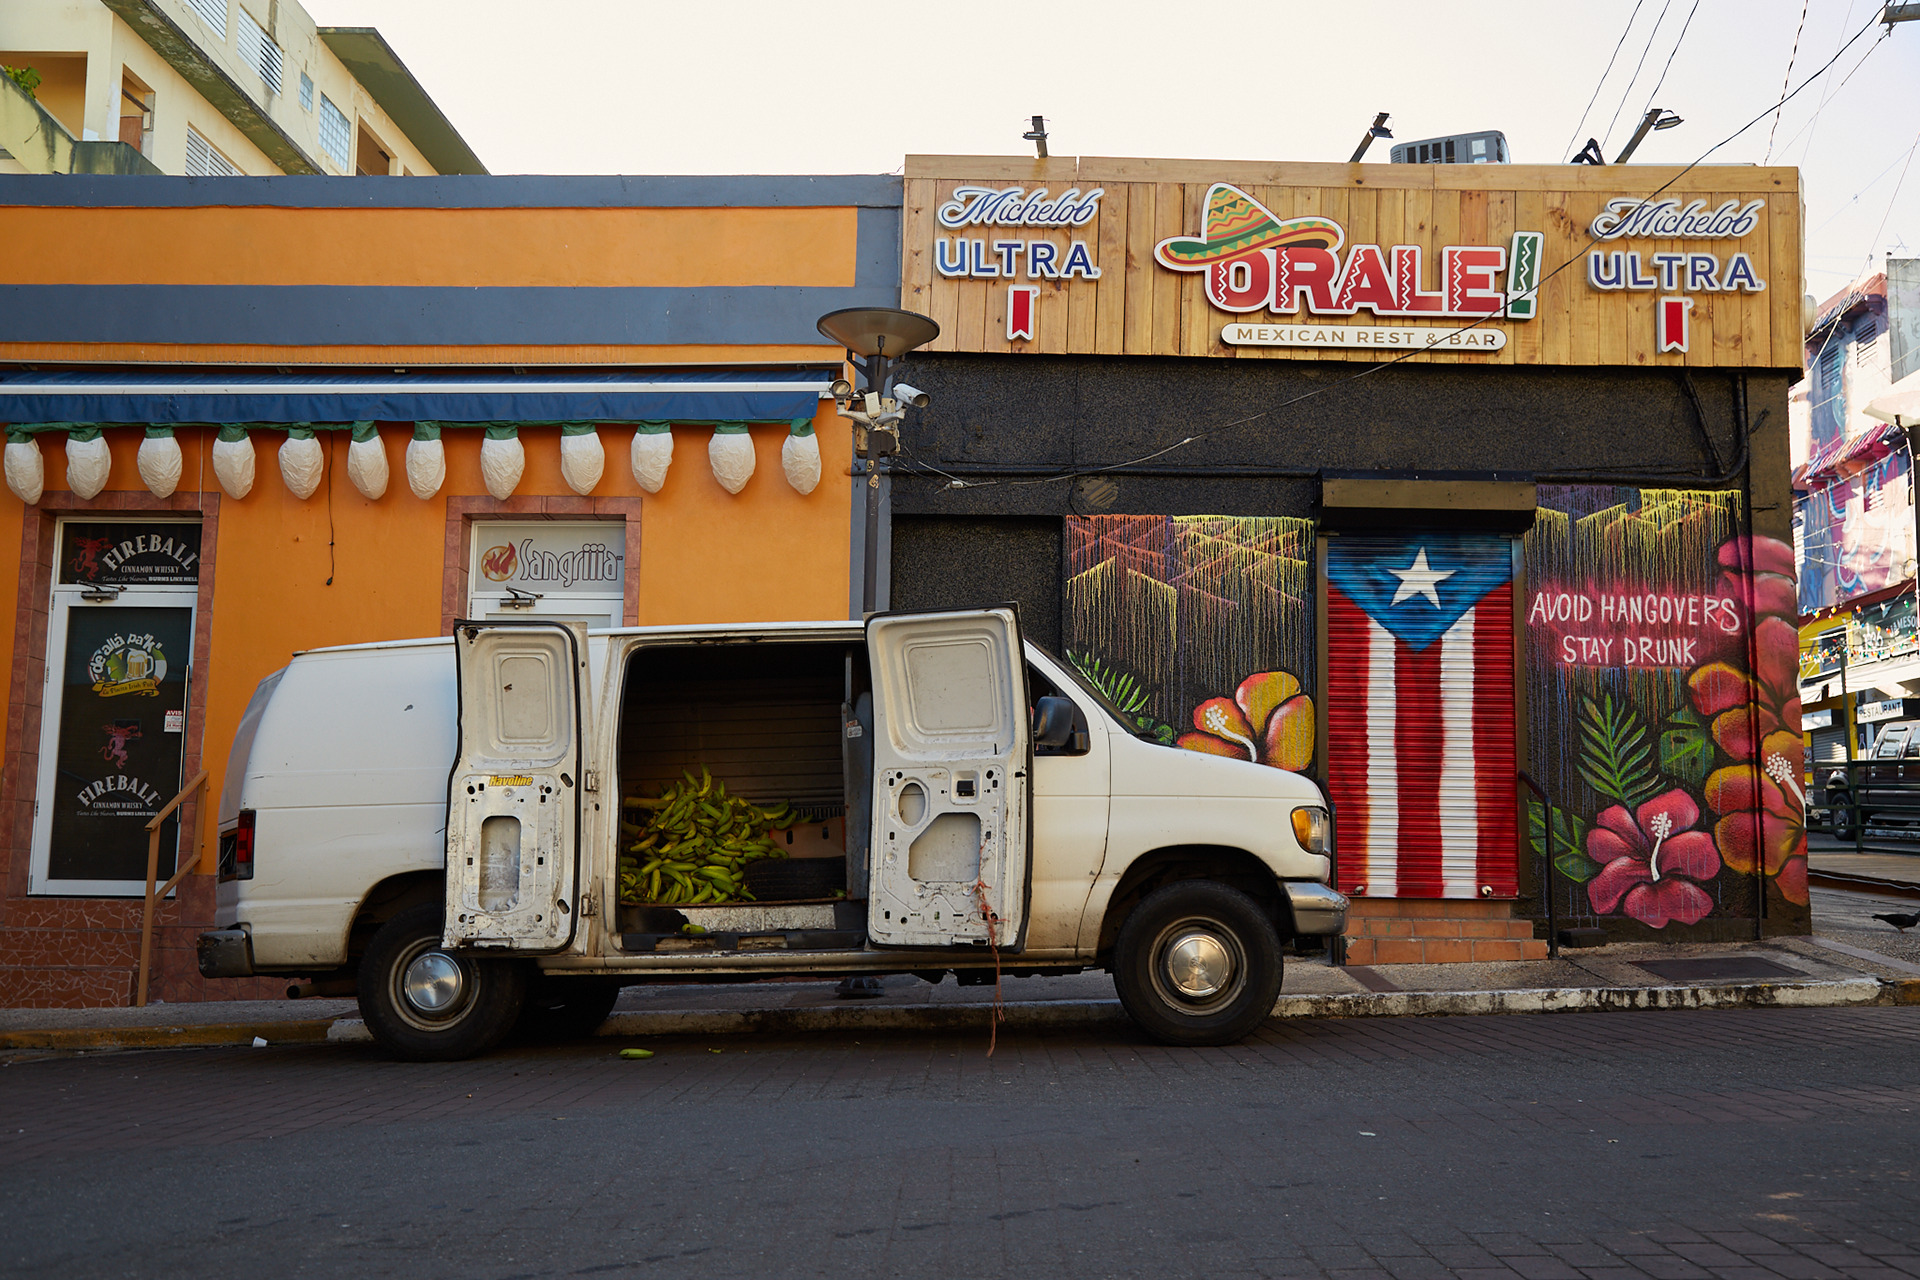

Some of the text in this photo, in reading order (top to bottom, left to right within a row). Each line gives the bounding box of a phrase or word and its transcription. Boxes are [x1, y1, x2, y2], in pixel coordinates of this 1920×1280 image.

[940, 188, 1103, 226] Michelob
[1593, 199, 1761, 237] Michelob
[938, 240, 1094, 276] ULTRA
[1592, 253, 1758, 289] ULTRA
[1236, 327, 1497, 346] MEXICAN REST & BAR
[102, 533, 198, 572] FIREBALL
[120, 565, 180, 574] CINNAMON WHISKY
[1529, 592, 1741, 632] AVOID HANGOVERS
[1562, 635, 1697, 665] STAY DRUNK
[1858, 701, 1902, 719] RESTAURANT
[76, 774, 159, 808] FIREBALL
[488, 775, 534, 787] Havoline
[92, 801, 144, 809] CINNAMON WHISKY
